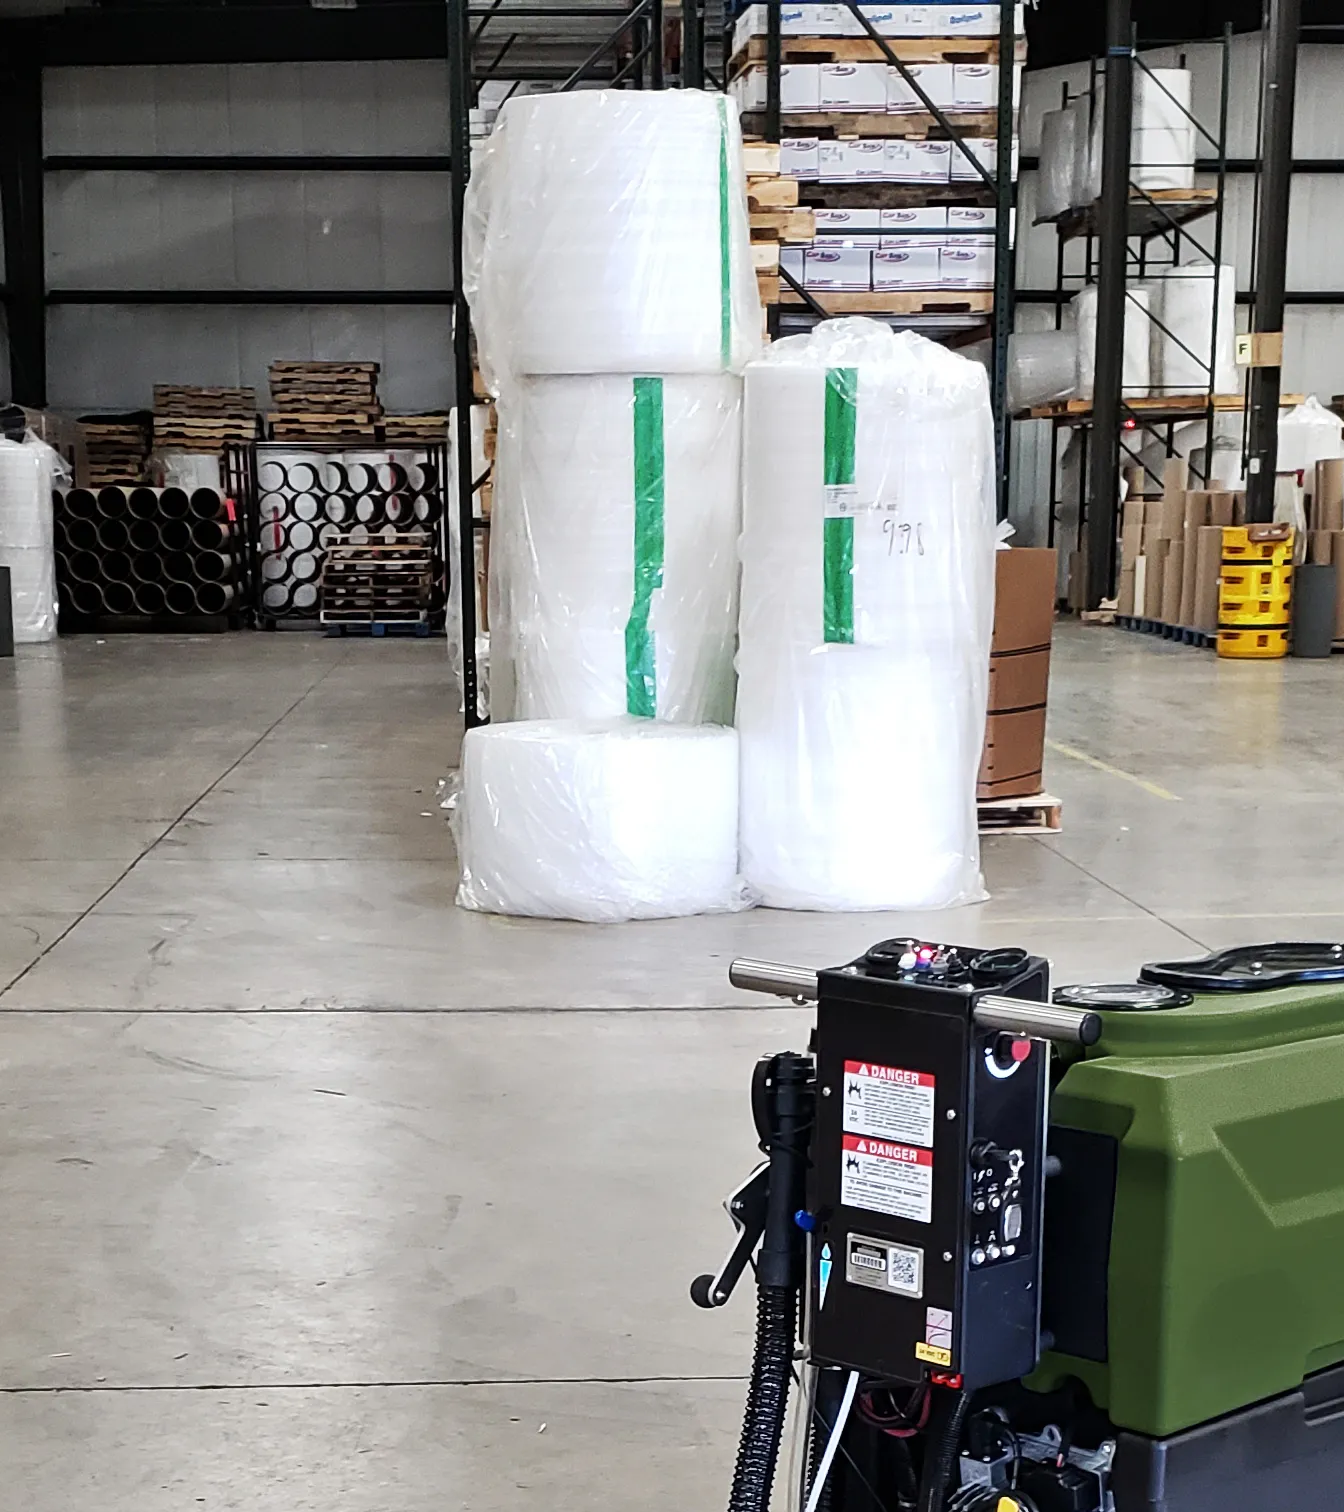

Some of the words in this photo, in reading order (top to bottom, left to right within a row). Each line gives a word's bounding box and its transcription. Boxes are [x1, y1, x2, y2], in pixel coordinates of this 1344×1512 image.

[1239, 343, 1248, 355] F
[871, 1065, 920, 1085] DANGER
[869, 1141, 918, 1162] DANGER
